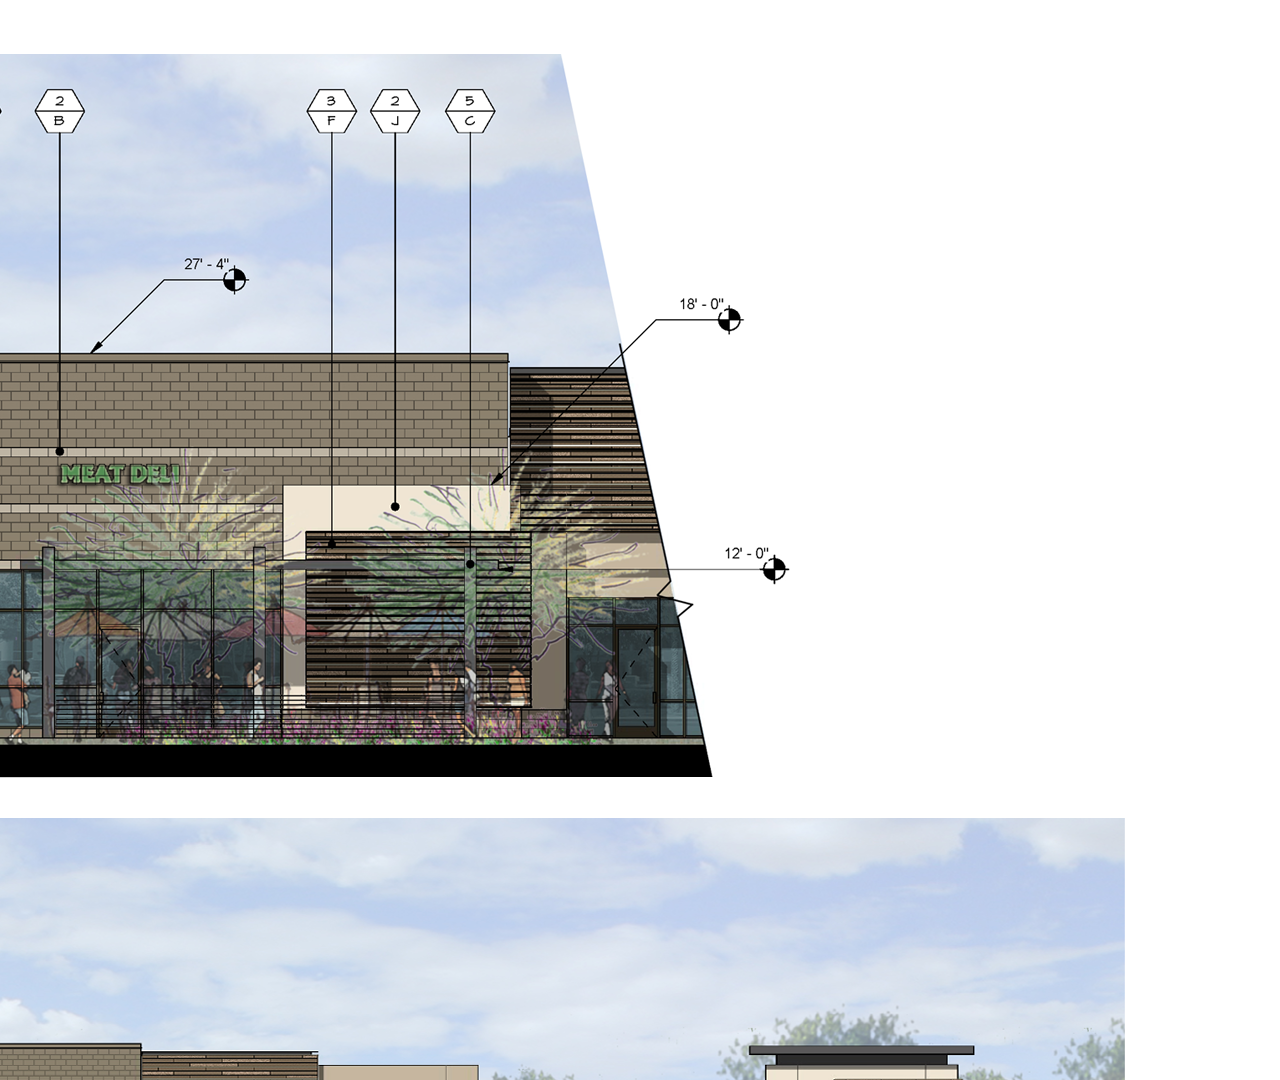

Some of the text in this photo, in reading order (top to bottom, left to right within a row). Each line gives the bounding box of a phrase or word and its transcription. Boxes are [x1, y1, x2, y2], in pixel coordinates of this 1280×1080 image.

[55, 95, 65, 107] 2
[326, 95, 336, 107] 3
[390, 95, 400, 107] 2
[465, 95, 475, 107] 5
[53, 115, 65, 126] B
[327, 115, 336, 126] F
[390, 115, 399, 126] J
[464, 115, 476, 126] C
[184, 257, 203, 270] 27'
[680, 297, 698, 310] 18'
[60, 464, 180, 484] MEAT DELI
[725, 547, 743, 560] 12'
